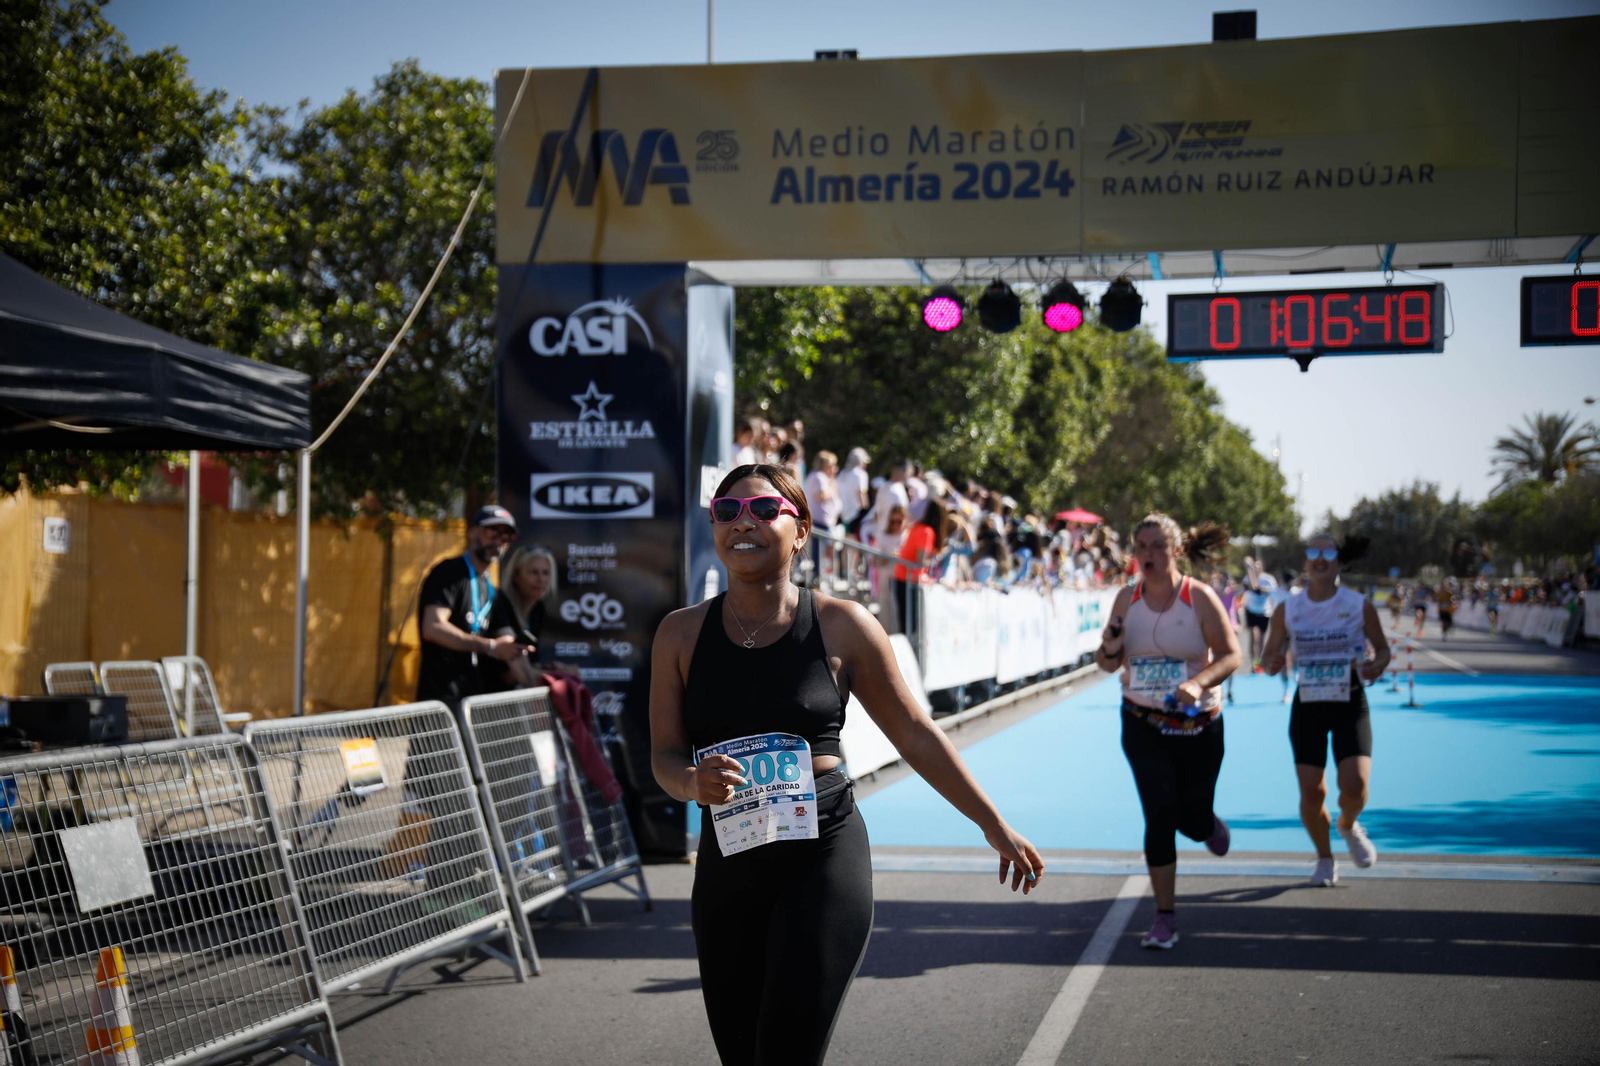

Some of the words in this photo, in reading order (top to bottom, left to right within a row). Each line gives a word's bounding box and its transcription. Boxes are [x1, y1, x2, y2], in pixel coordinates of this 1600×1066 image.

[696, 130, 739, 160] 25
[772, 126, 888, 158] Medio
[908, 120, 1075, 155] Maratón
[769, 162, 941, 204] Almería
[952, 159, 1075, 200] 2024
[1102, 170, 1204, 196] RAMÓN
[1217, 171, 1283, 192] RUIZ
[1294, 162, 1435, 188] ANDÚJAR
[529, 316, 628, 356] CASI
[529, 421, 655, 439] ESTRELLA
[547, 485, 640, 506] IKEA
[567, 542, 617, 556] Barceló
[560, 592, 624, 630] ego
[726, 742, 743, 750] Medio
[743, 737, 768, 746] Maratón
[727, 745, 750, 756] Almería
[750, 742, 769, 750] 2024
[734, 751, 801, 792] 208
[755, 787, 764, 795] LA
[766, 783, 800, 792] CARIDAD
